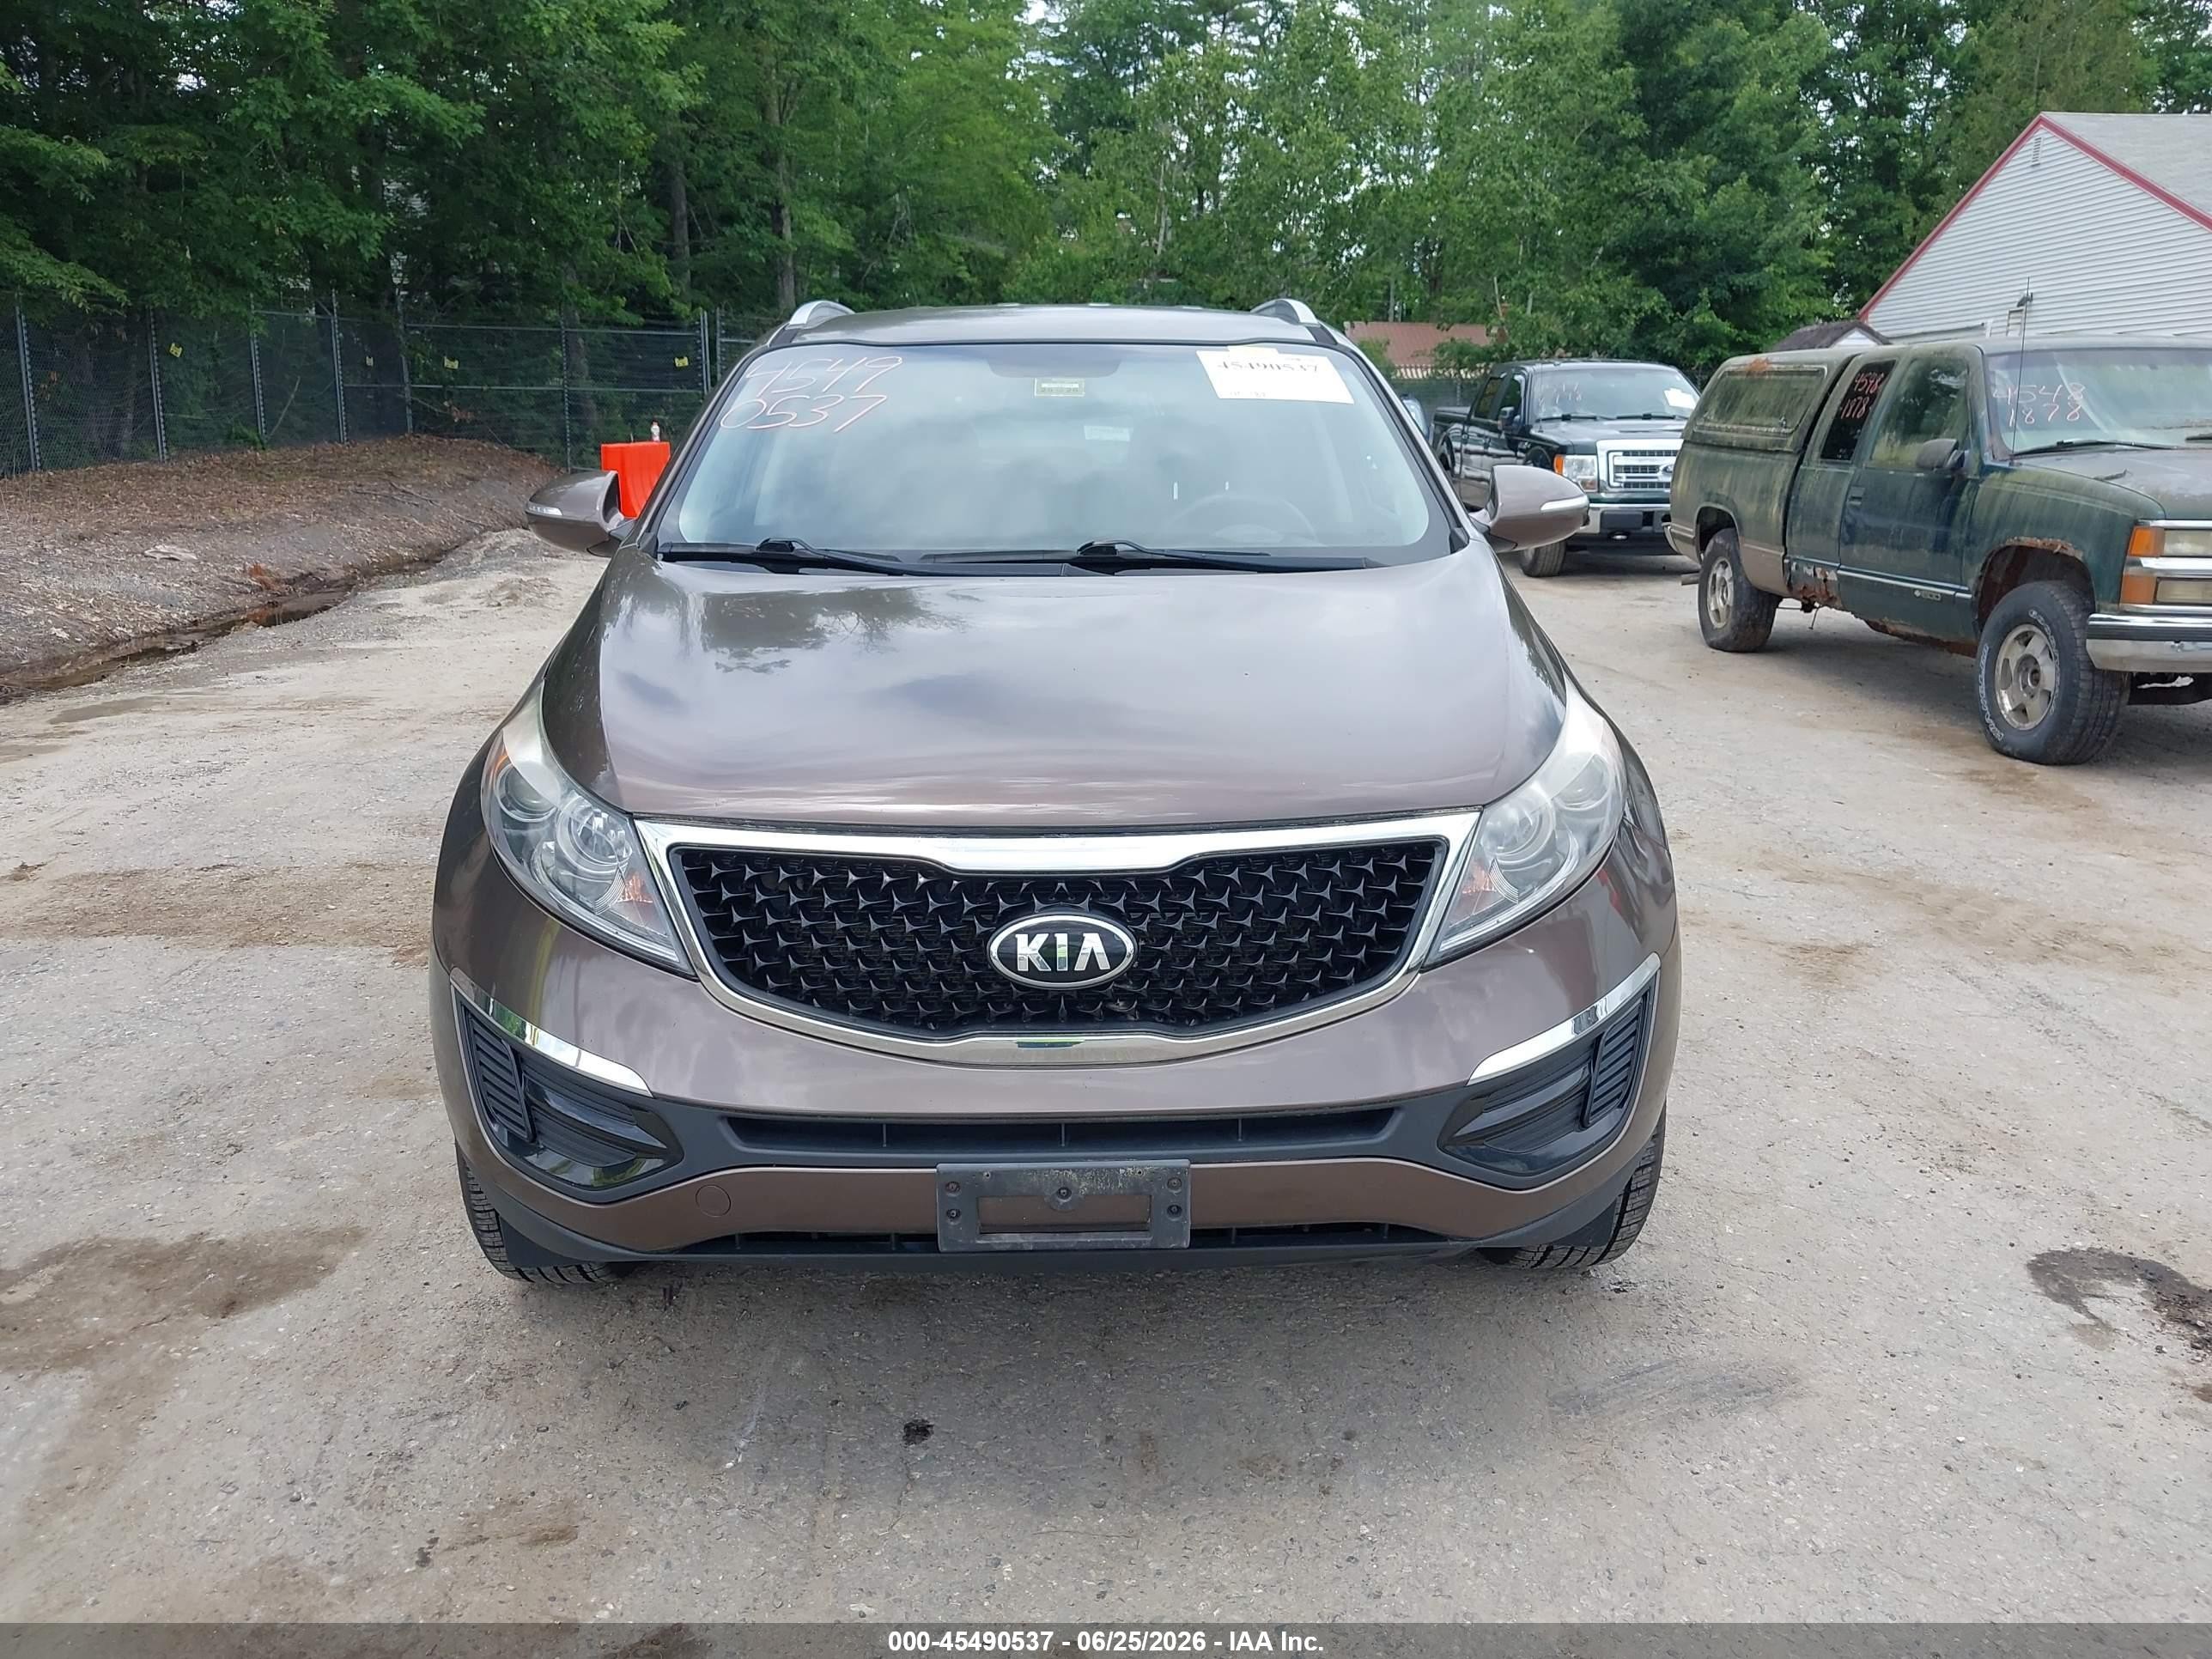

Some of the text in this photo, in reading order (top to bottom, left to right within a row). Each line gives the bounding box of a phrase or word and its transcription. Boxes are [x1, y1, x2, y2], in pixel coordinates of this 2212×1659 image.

[745, 356, 902, 398] 4549
[1992, 381, 2086, 405] 4548
[720, 394, 888, 433] 0537
[2008, 402, 2082, 428] 1878
[1014, 932, 1112, 972] KIA
